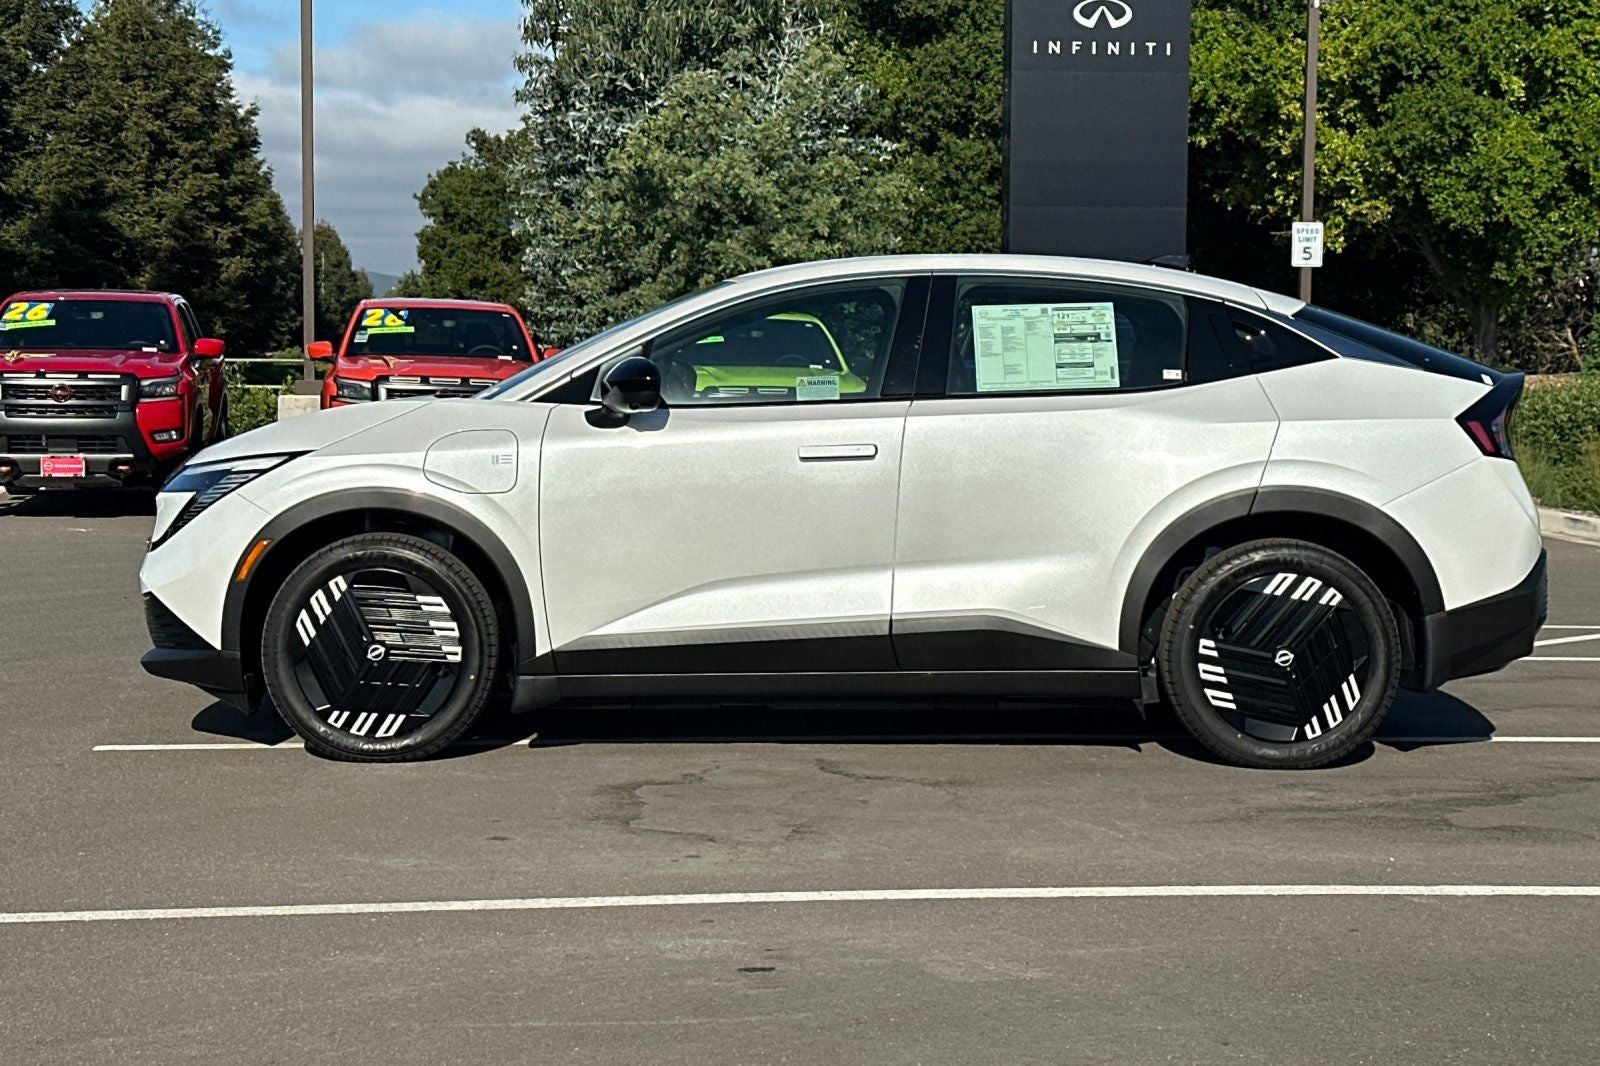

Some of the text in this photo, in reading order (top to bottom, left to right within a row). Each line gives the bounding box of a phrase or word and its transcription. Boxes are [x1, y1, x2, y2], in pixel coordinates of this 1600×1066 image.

[1033, 40, 1171, 56] INFINITI
[1302, 246, 1312, 261] 5
[2, 301, 50, 320] 26
